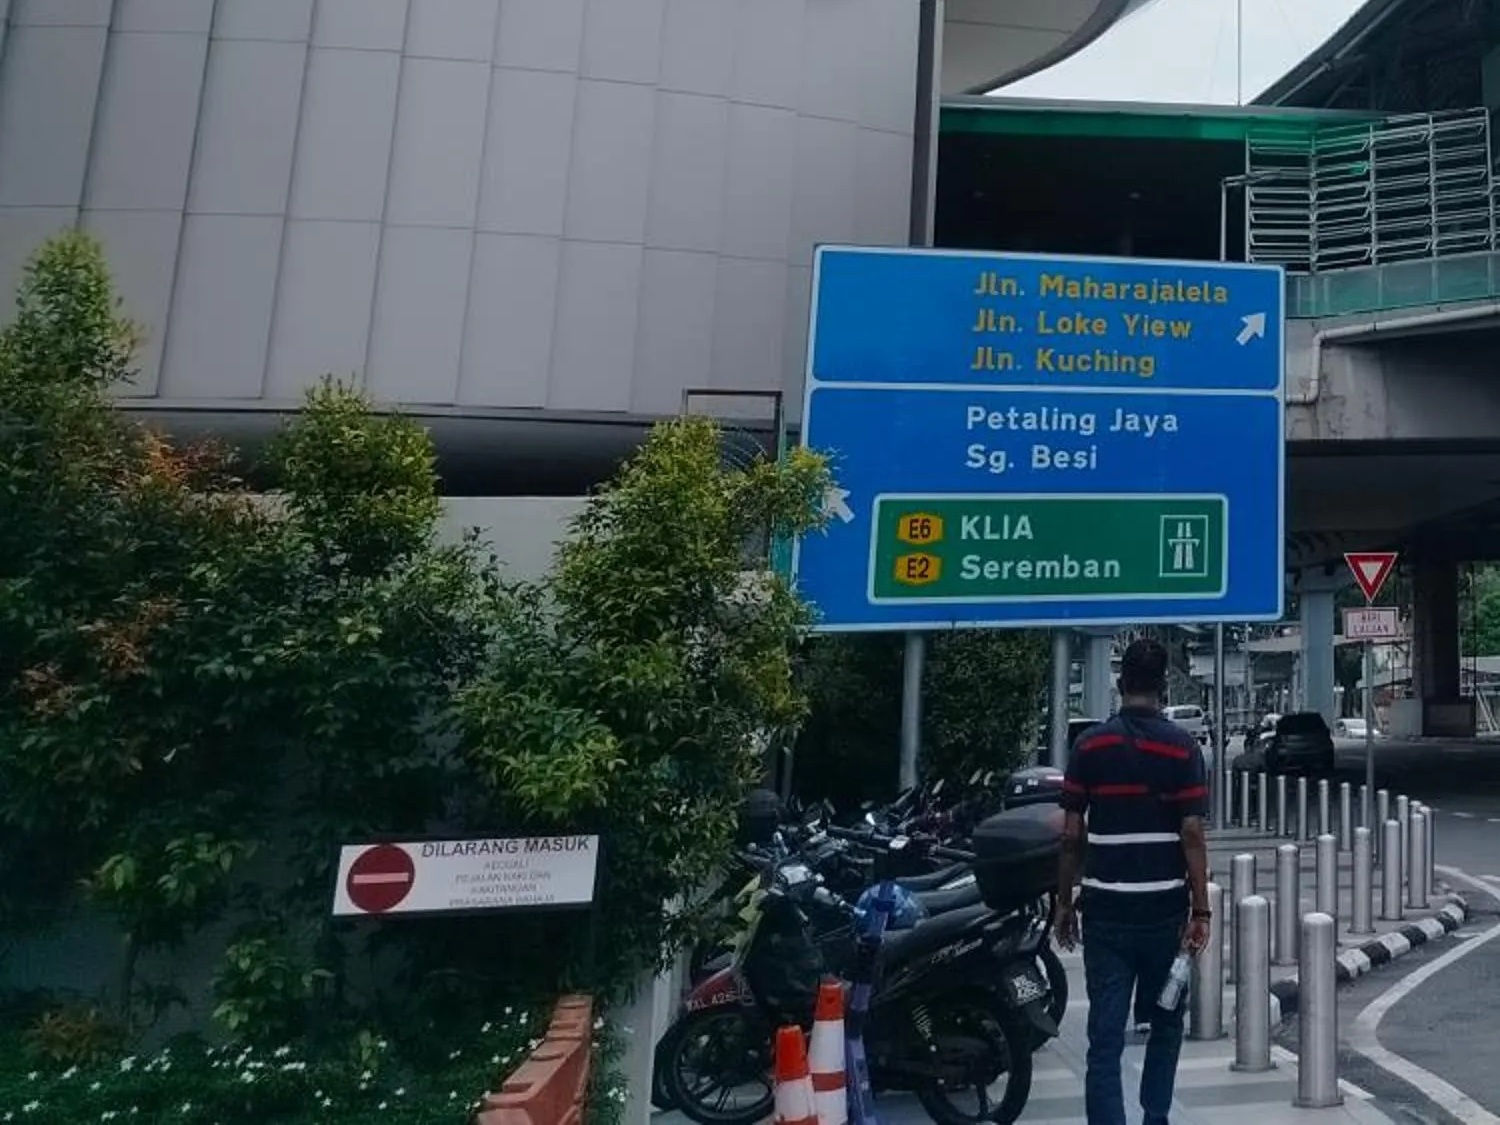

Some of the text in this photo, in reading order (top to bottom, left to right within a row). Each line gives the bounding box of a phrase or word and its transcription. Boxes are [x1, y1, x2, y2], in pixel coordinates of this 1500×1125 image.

[974, 271, 1229, 305] Jln. Maharajalela
[972, 309, 1192, 339] Jln. Loke Yiew
[970, 346, 1157, 377] Jln. Kuching
[965, 405, 1179, 438] Petaling Jaya
[964, 442, 1098, 474] Sg. Besi
[908, 517, 932, 540] E6
[960, 514, 1034, 541] KLIA
[906, 557, 930, 580] E2
[959, 553, 1122, 581] Seremban
[421, 836, 590, 858] DILARANG MASUK
